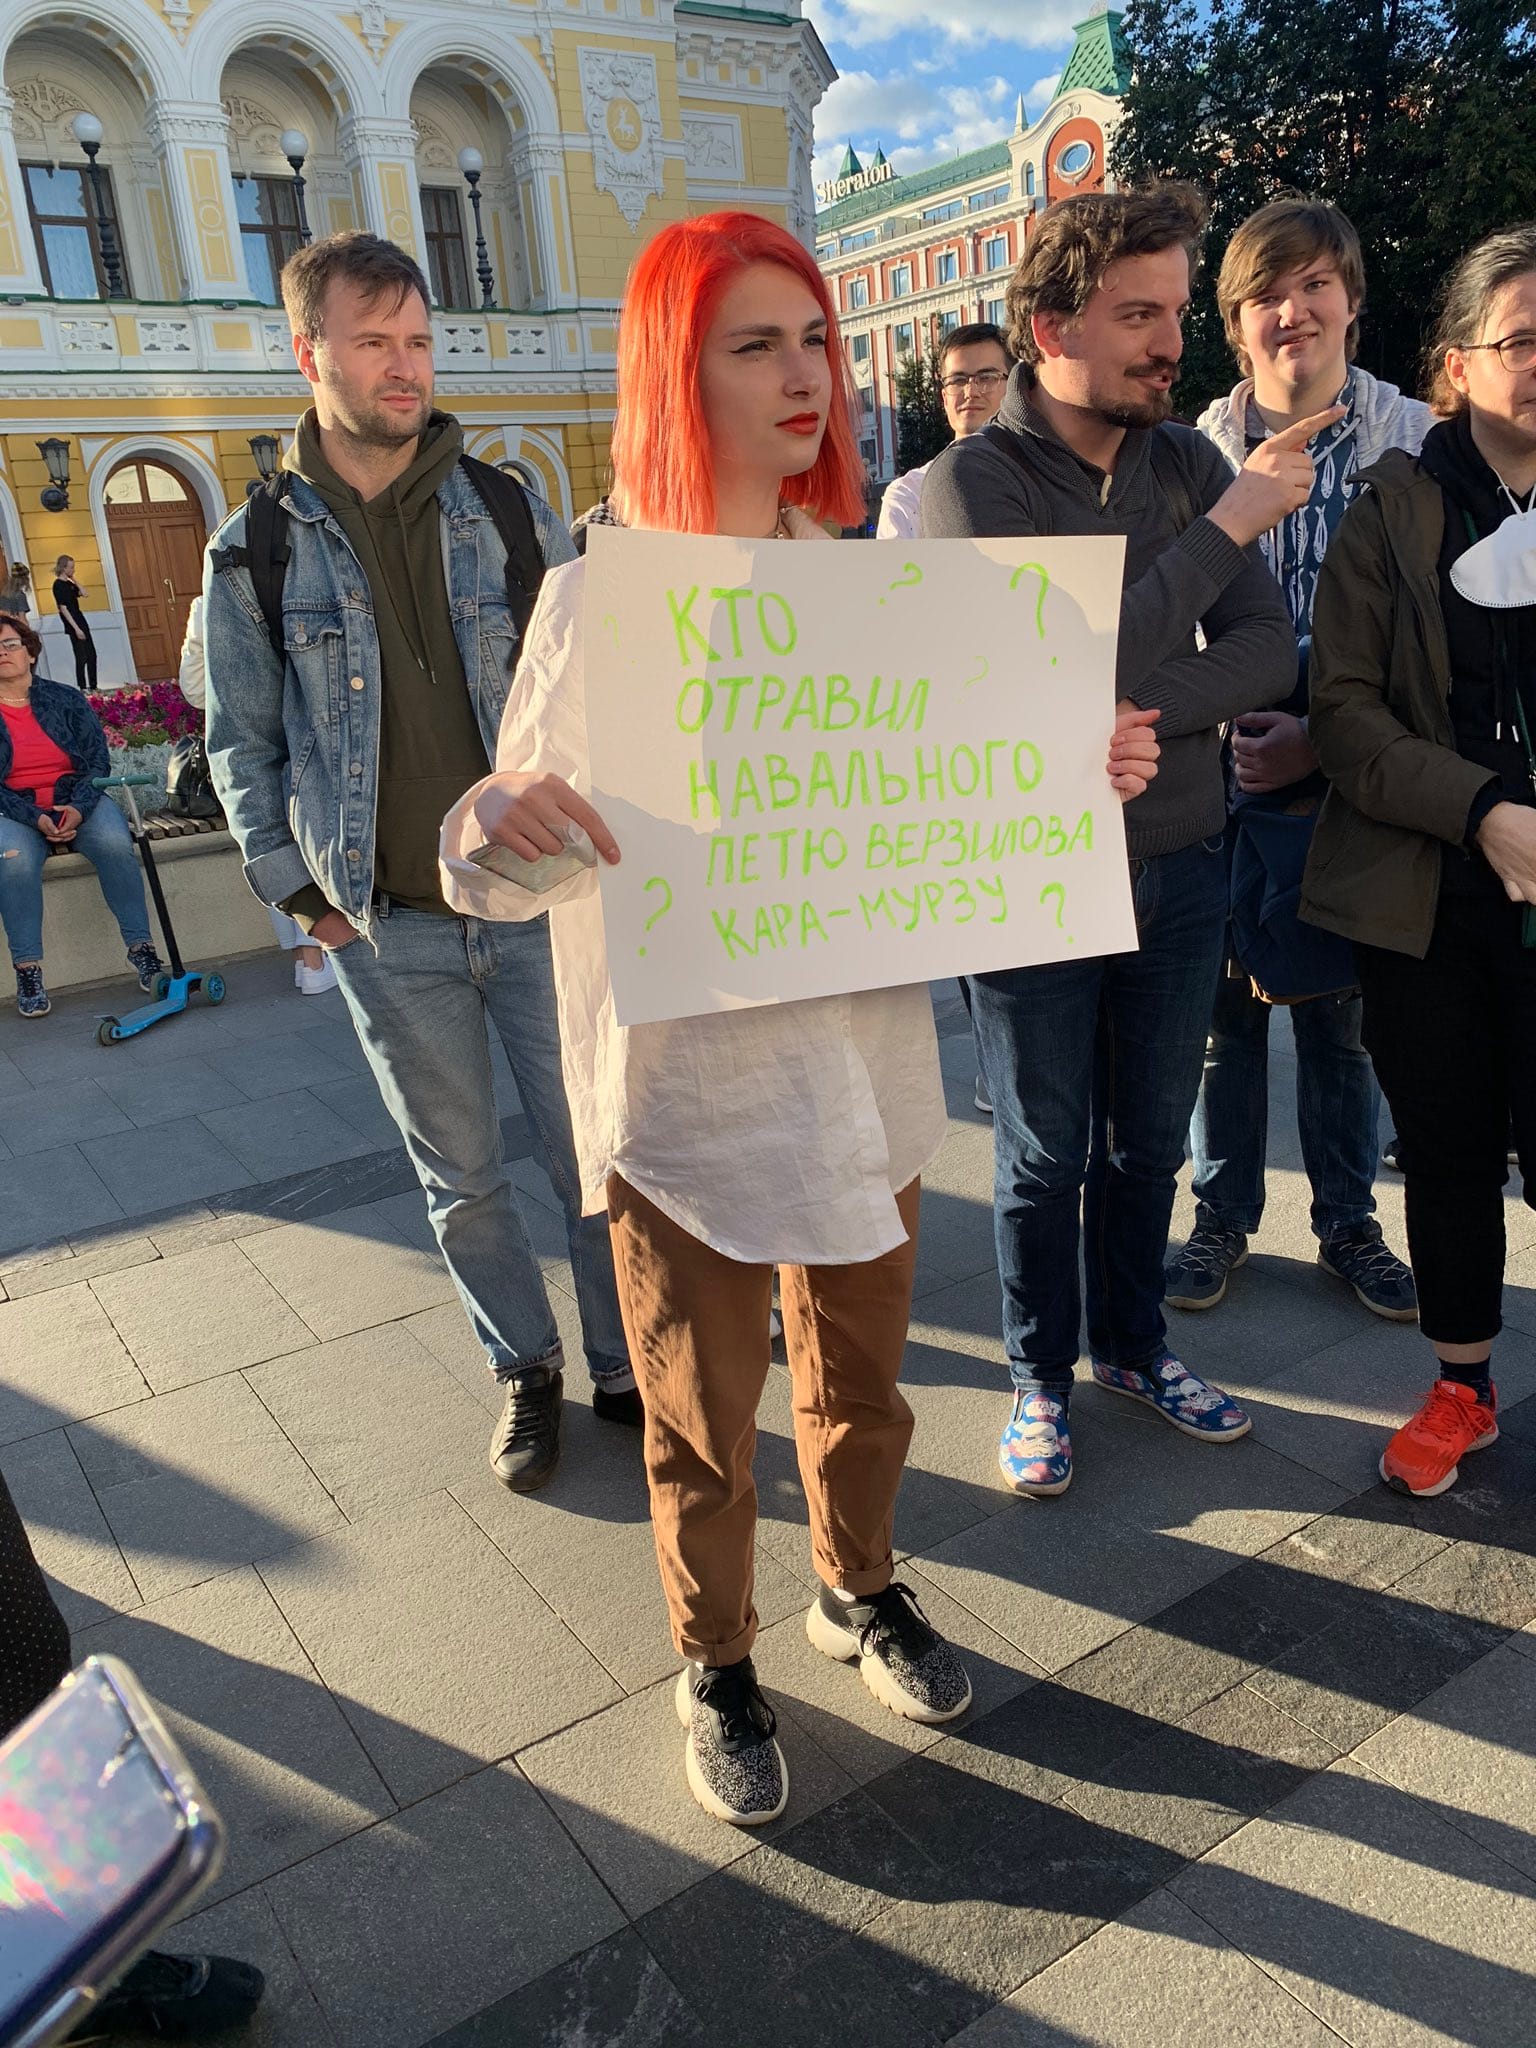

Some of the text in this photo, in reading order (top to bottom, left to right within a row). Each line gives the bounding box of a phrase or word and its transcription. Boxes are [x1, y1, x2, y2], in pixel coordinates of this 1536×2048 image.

[816, 163, 892, 205] Sheraton
[880, 561, 924, 606] ?
[1008, 562, 1058, 667] ?
[666, 585, 799, 666] КТО
[676, 673, 932, 735] ОТРАВИЛ
[688, 739, 1045, 820] НАВАЛЬНОГО
[705, 809, 1094, 888] ПЕТЮ ВЕРЗИЛОВА
[637, 876, 673, 958] ?
[710, 874, 1075, 961] КАРА-МУРЗУ ?
